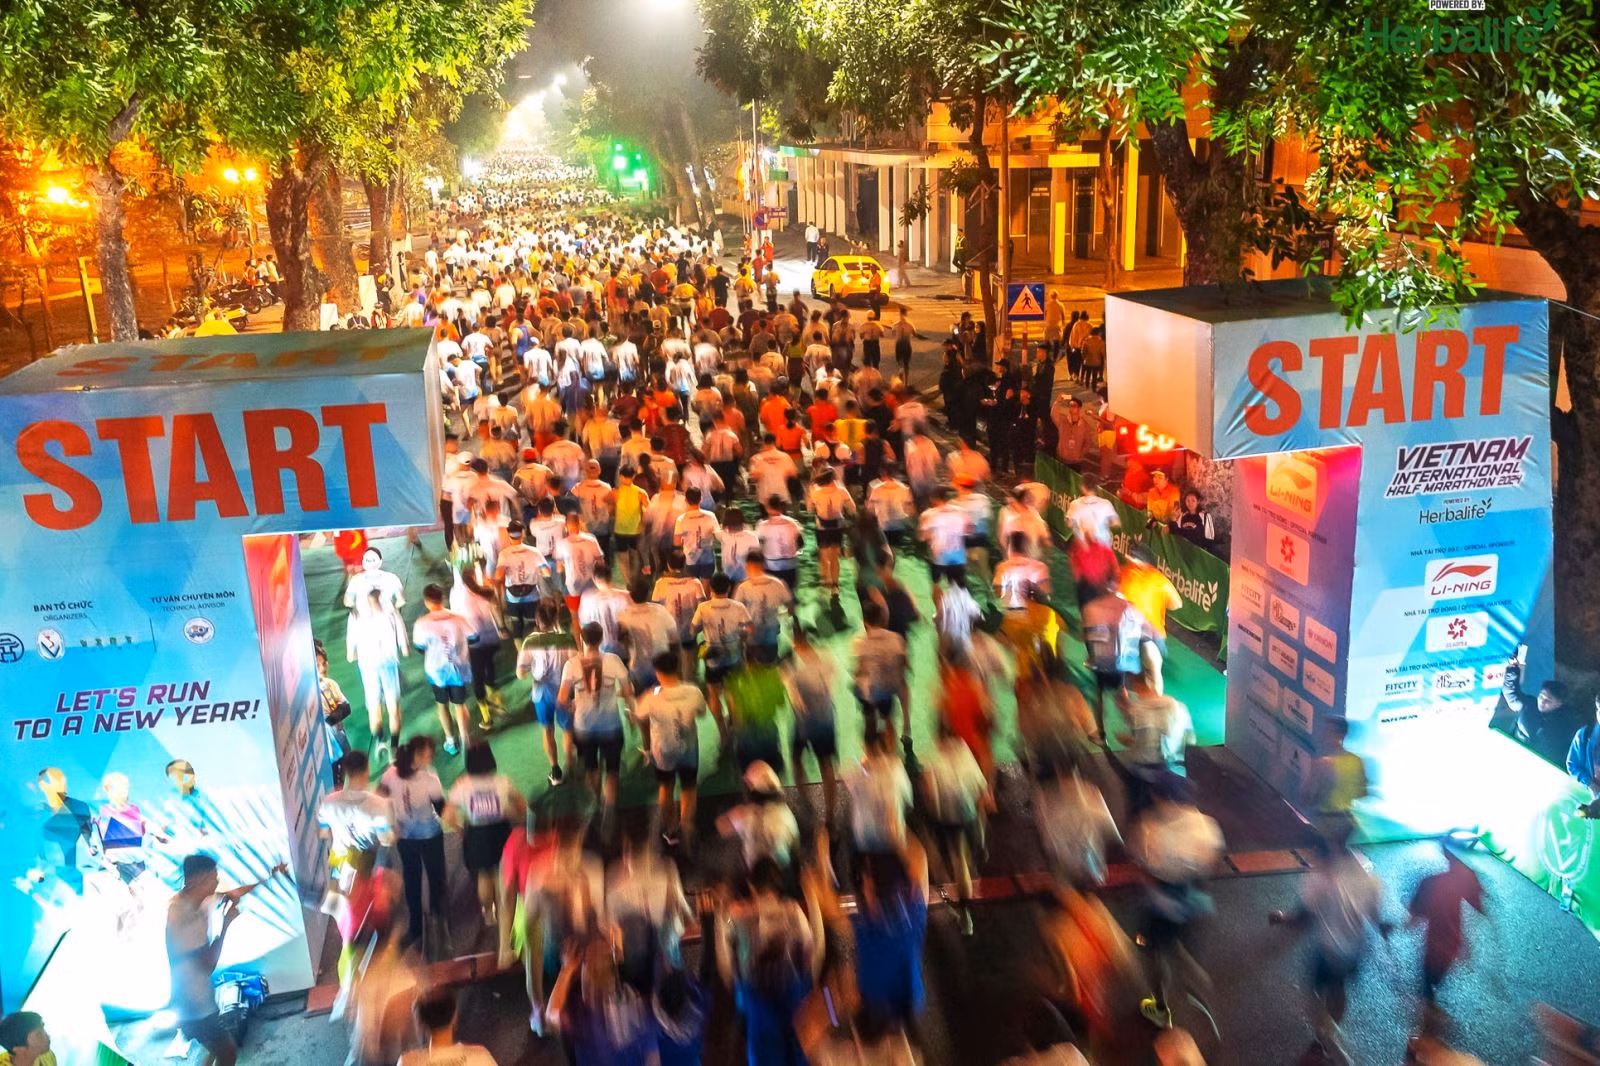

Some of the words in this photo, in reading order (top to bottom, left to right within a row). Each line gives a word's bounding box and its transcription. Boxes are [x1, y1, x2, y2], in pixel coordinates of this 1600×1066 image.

[1244, 324, 1520, 437] START
[1397, 437, 1532, 471] VIETNAM
[15, 402, 388, 531] START
[1392, 462, 1521, 486] INTERNATIONAL
[1386, 484, 1421, 497] HALF
[1424, 477, 1497, 493] MARATHON
[1419, 504, 1485, 524] Herbalife
[1157, 555, 1211, 612] Herbalife
[1431, 580, 1492, 596] LI-NING
[181, 592, 214, 602] CHUYÊN
[216, 590, 235, 599] MÔN
[33, 603, 53, 613] BAN
[42, 612, 88, 621] ORGANIZERS
[162, 605, 197, 613] TECHNICAL
[1385, 680, 1418, 692] FITCITY
[56, 685, 138, 713] LET'S
[147, 680, 210, 705] RUN
[14, 717, 51, 740] TO
[62, 715, 82, 736] A
[93, 708, 164, 733] NEW
[174, 699, 260, 726] YEAR!
